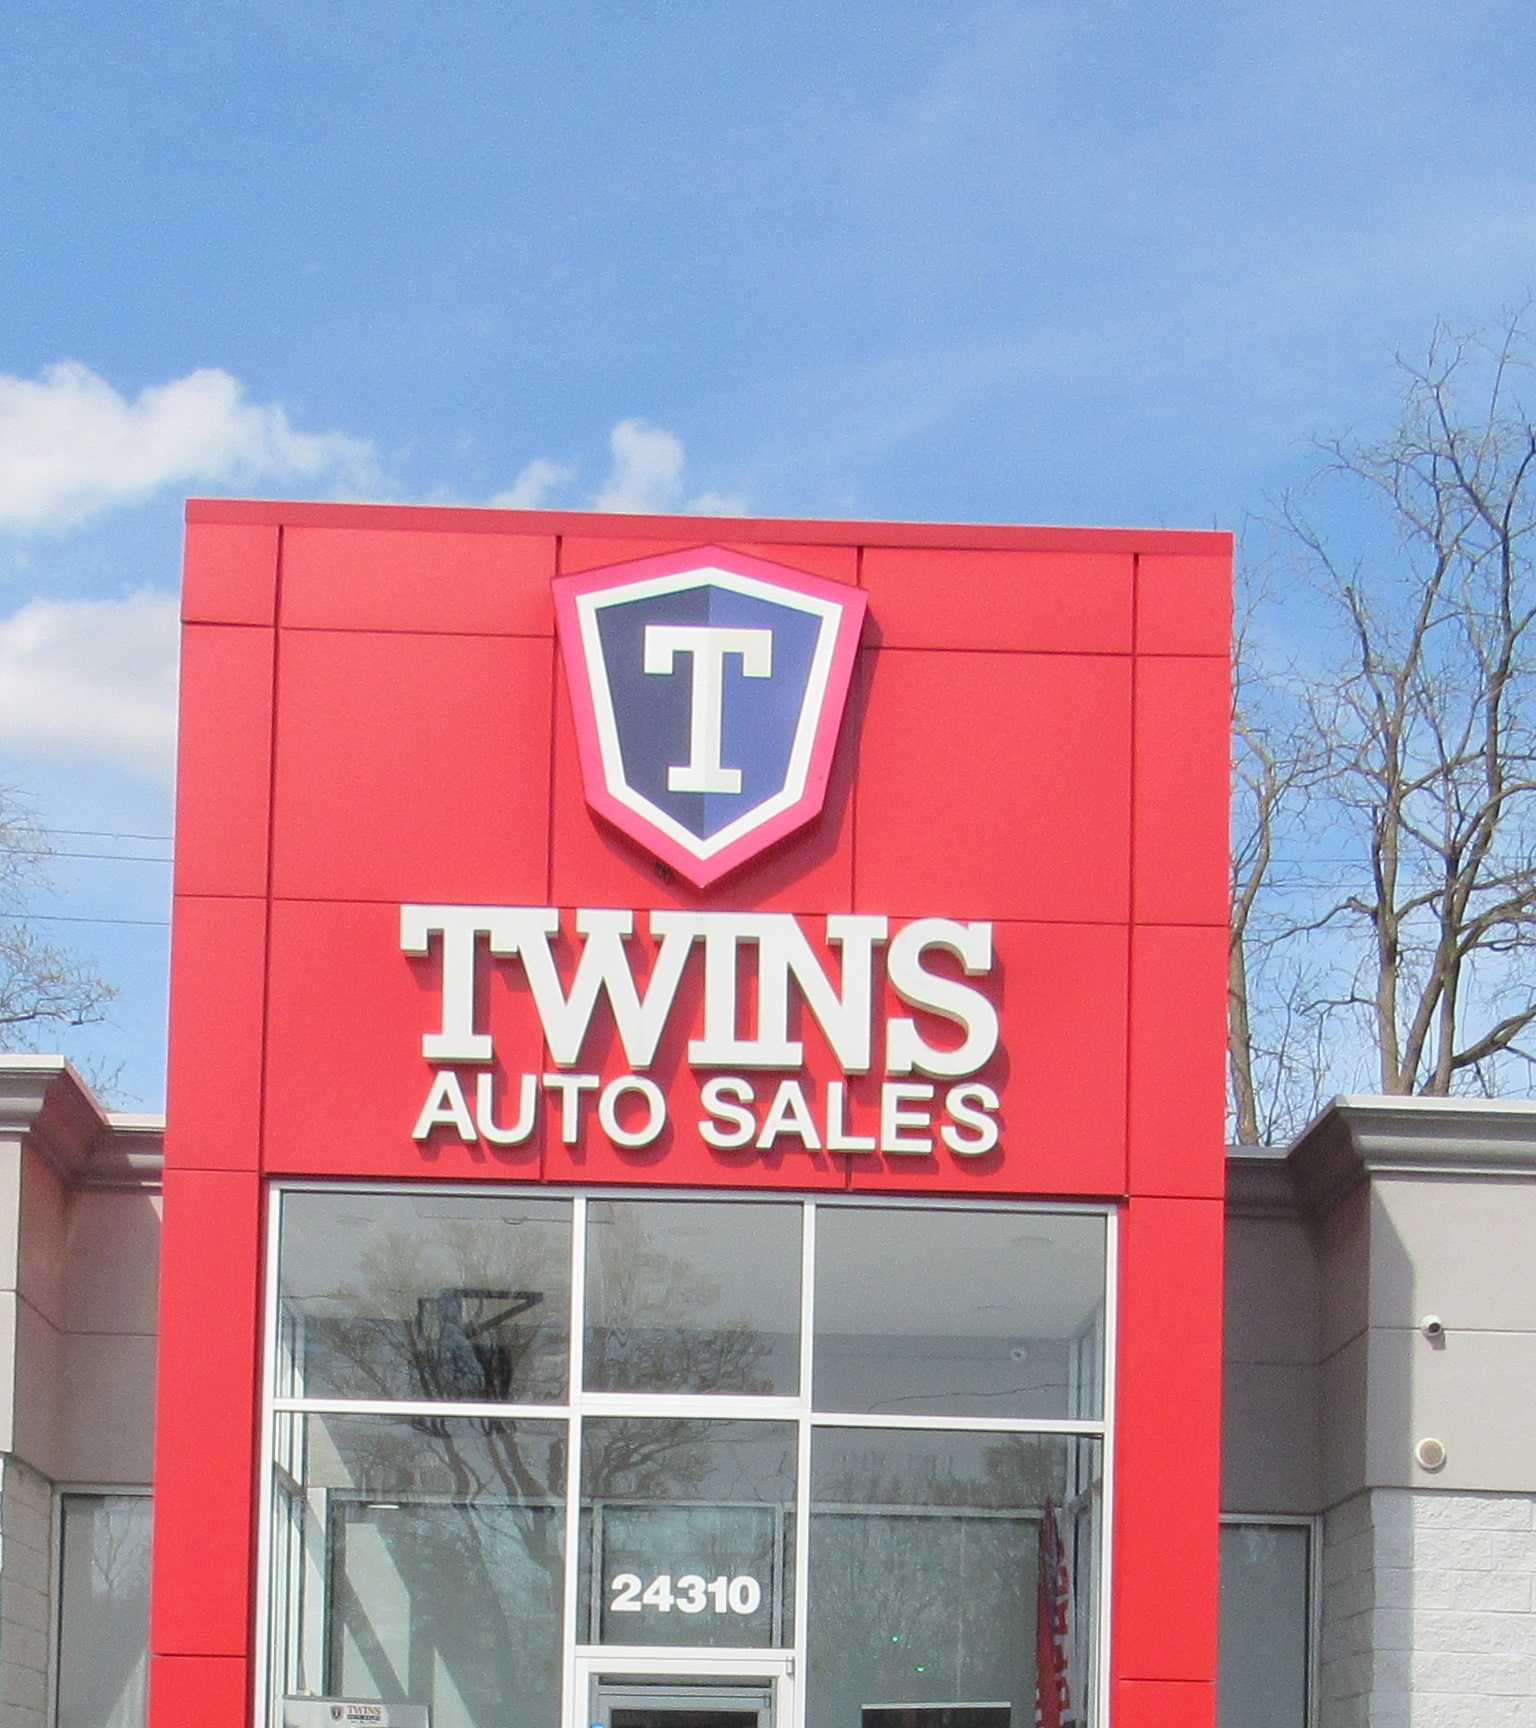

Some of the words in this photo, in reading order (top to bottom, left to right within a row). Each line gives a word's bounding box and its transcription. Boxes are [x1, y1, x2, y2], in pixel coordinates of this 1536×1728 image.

[642, 624, 773, 794] T
[400, 903, 1000, 1081] TWINS
[412, 1070, 666, 1149] AUTO
[697, 1076, 1001, 1156] SALES
[609, 1573, 761, 1614] 24310
